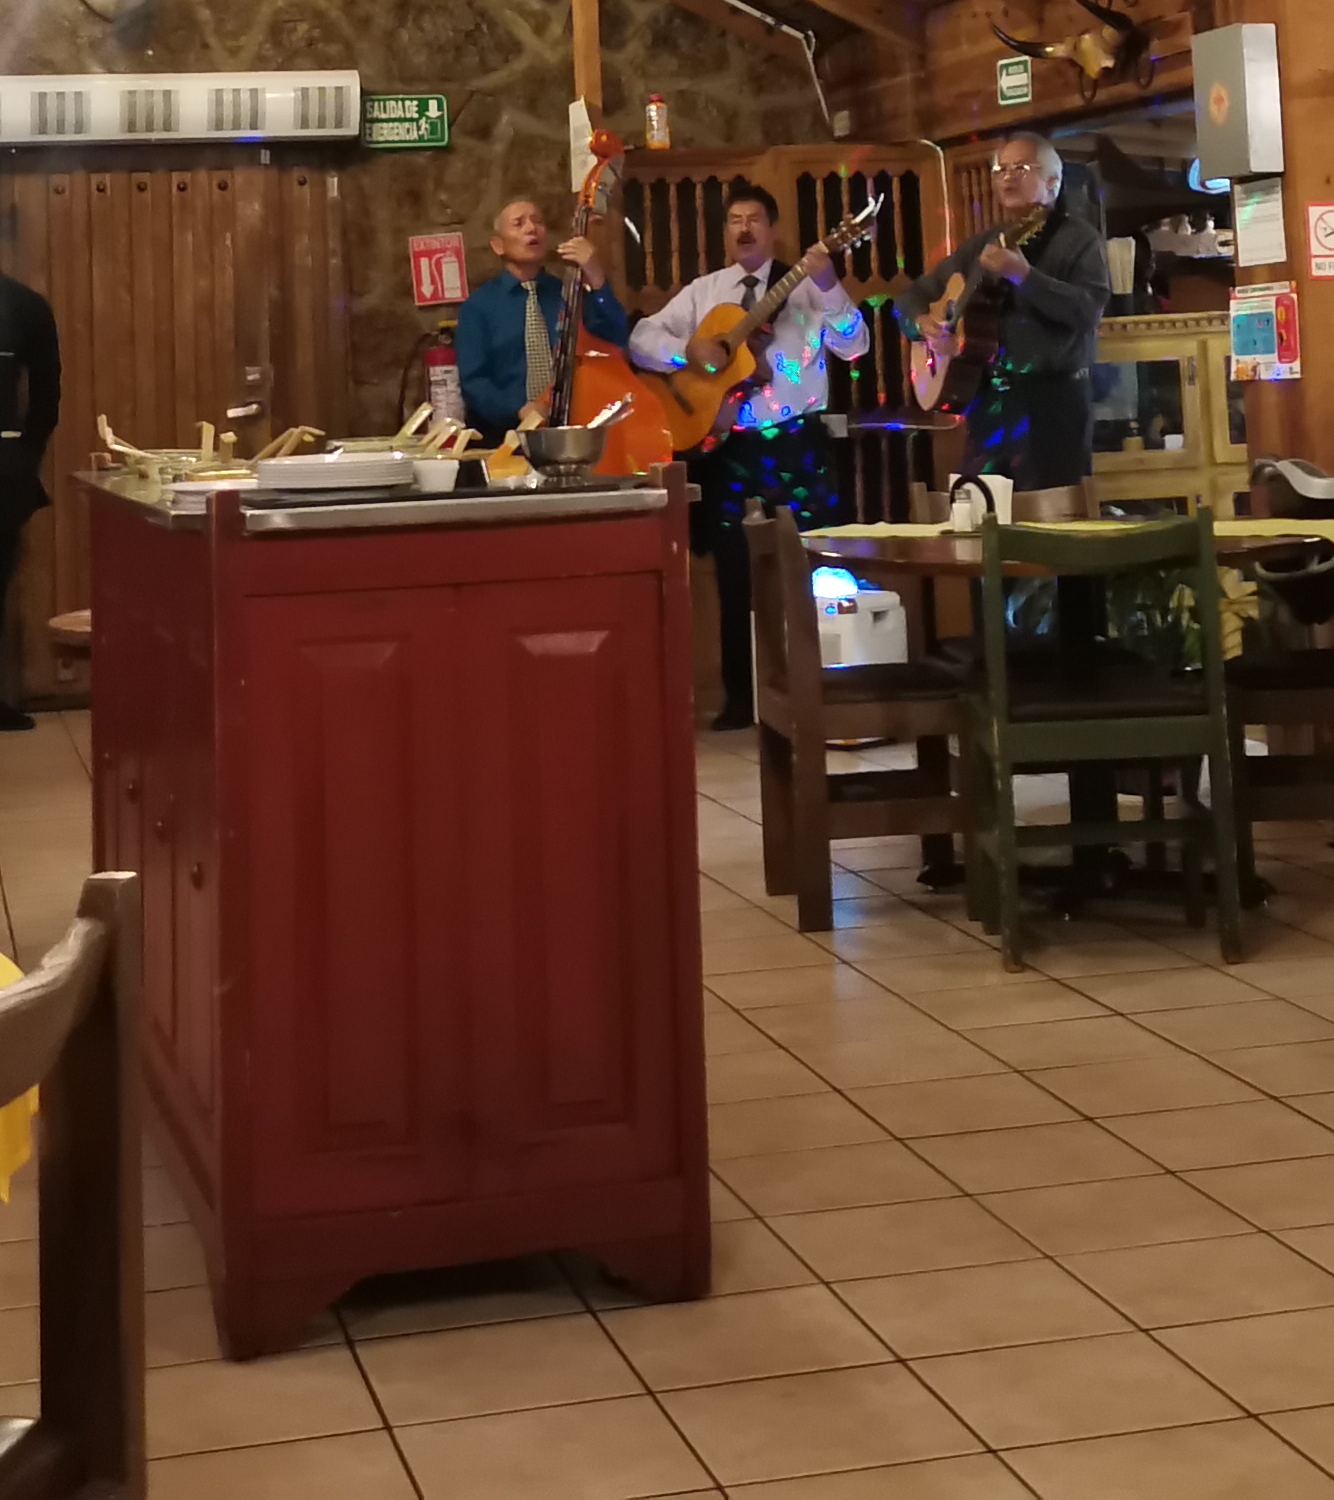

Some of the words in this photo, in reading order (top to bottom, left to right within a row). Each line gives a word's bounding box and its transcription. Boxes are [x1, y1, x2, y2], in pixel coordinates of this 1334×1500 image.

[366, 100, 404, 118] SALIDA
[405, 100, 419, 118] DE
[1315, 262, 1326, 270] NO
